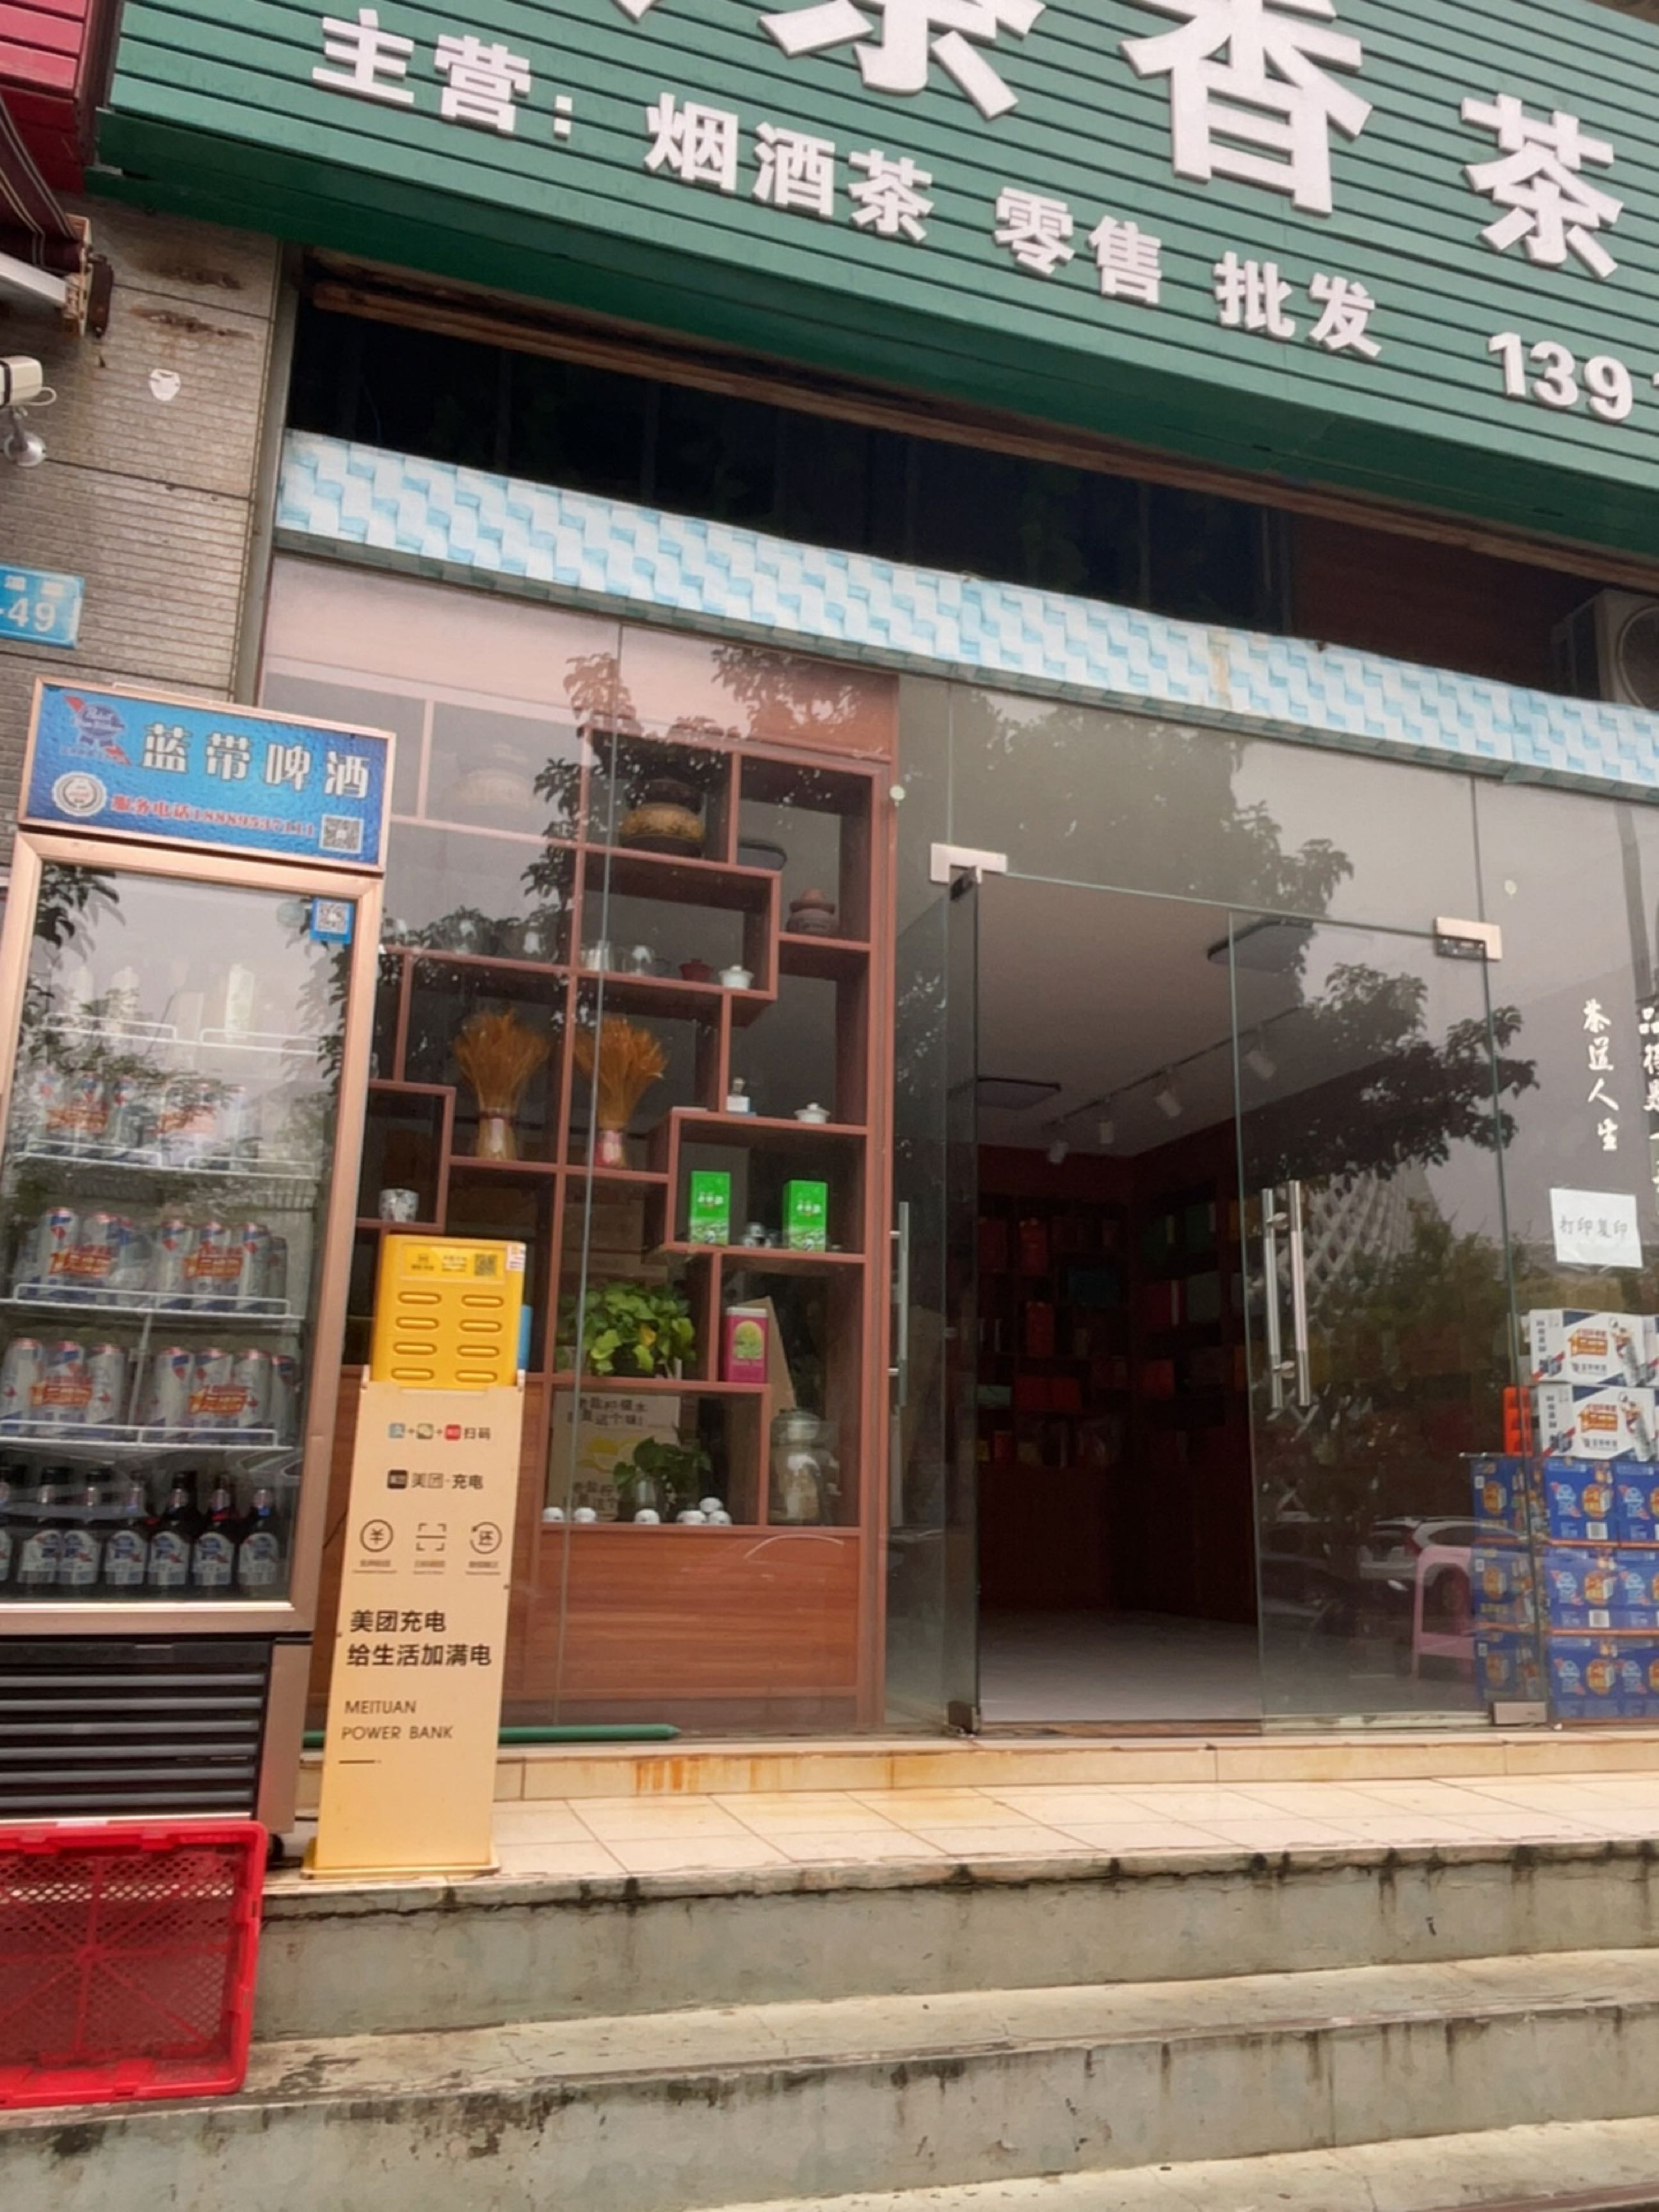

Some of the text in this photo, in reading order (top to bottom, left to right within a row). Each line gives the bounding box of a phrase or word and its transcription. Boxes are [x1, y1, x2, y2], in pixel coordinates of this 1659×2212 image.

[643, 92, 934, 242] 烟酒茶
[994, 187, 1162, 304] 零售
[1214, 250, 1382, 359] 批发
[1487, 332, 1659, 421] 139
[141, 721, 370, 800] 蓝带啤酒
[349, 1610, 446, 1633] 美团充电
[346, 1643, 492, 1666] 给生活加满电
[344, 1700, 417, 1714] MEITUAN
[341, 1726, 453, 1740] POWER BANK
